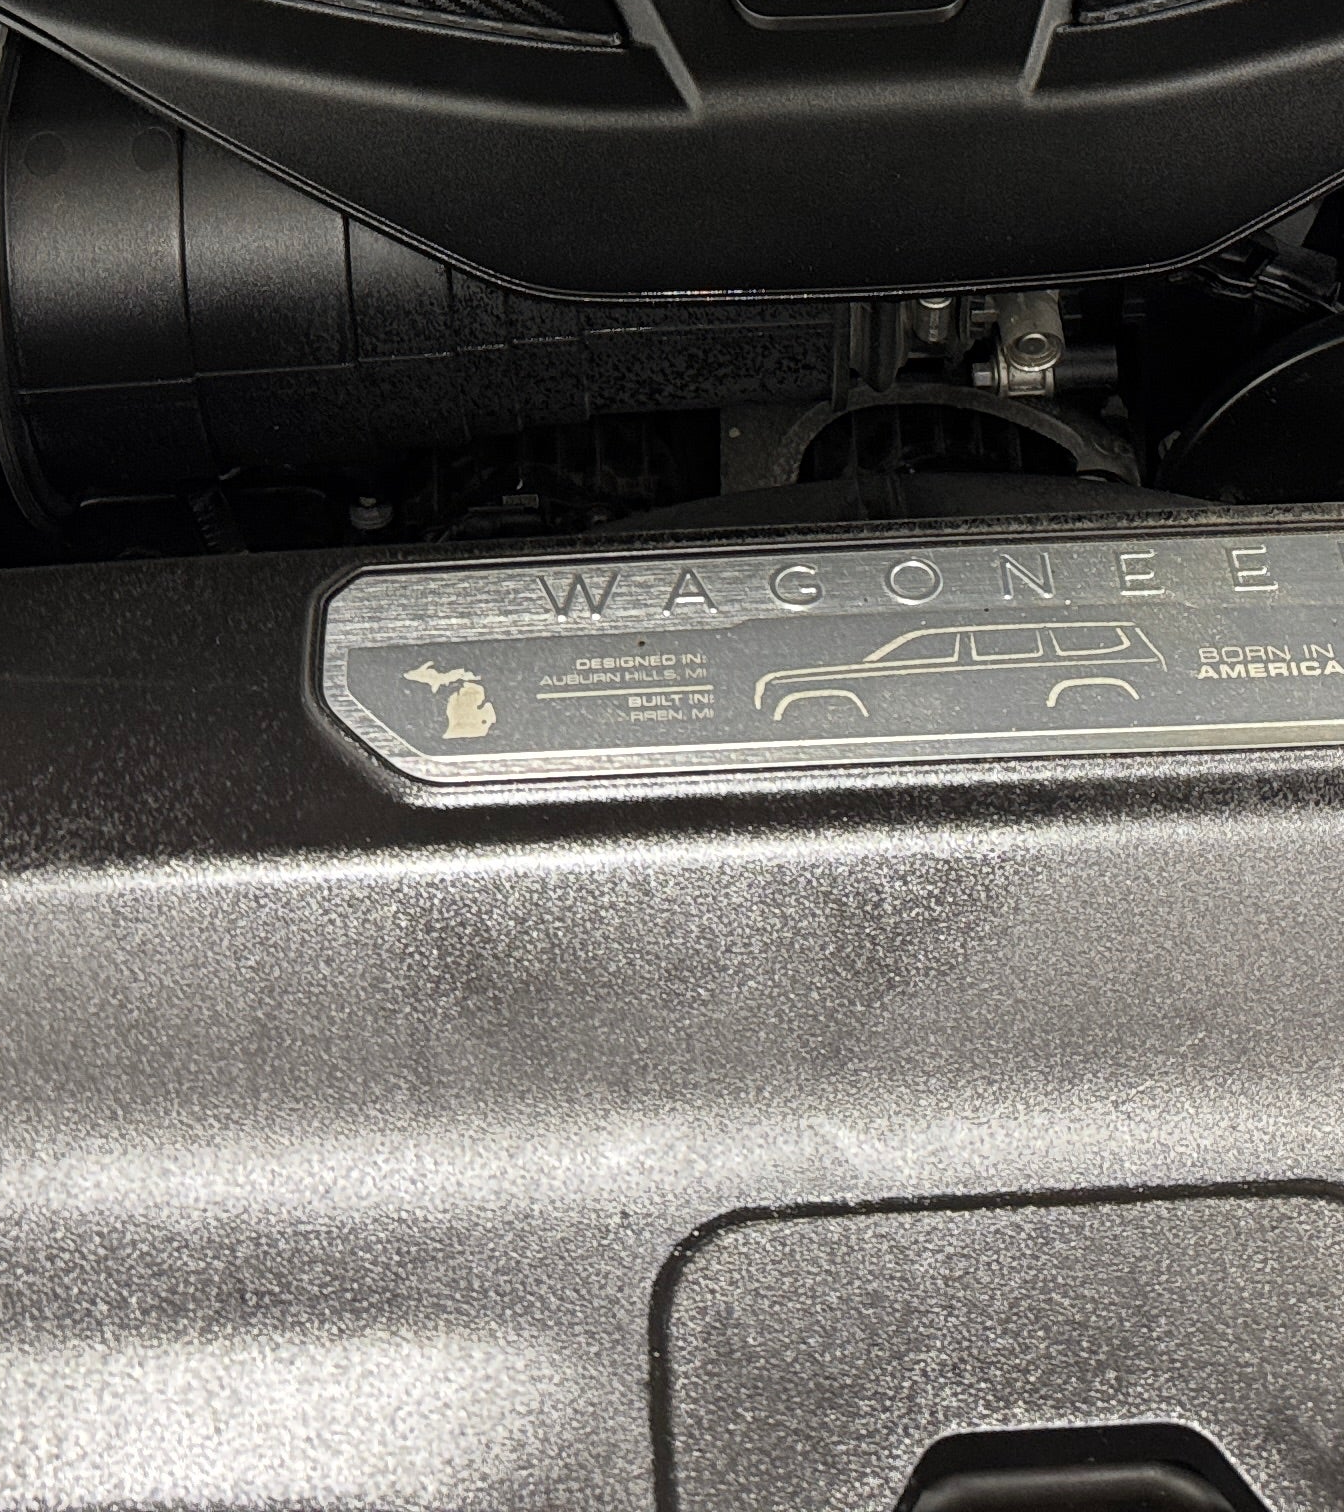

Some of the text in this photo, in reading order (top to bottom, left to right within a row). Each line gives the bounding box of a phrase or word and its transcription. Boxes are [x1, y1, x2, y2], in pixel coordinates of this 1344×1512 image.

[575, 652, 707, 670] DESIGNED IN:
[1198, 643, 1336, 664] BORN IN
[538, 667, 707, 687] AUBURN HILLS, MI
[627, 693, 715, 709] BUILT IN:
[691, 707, 715, 721] MI
